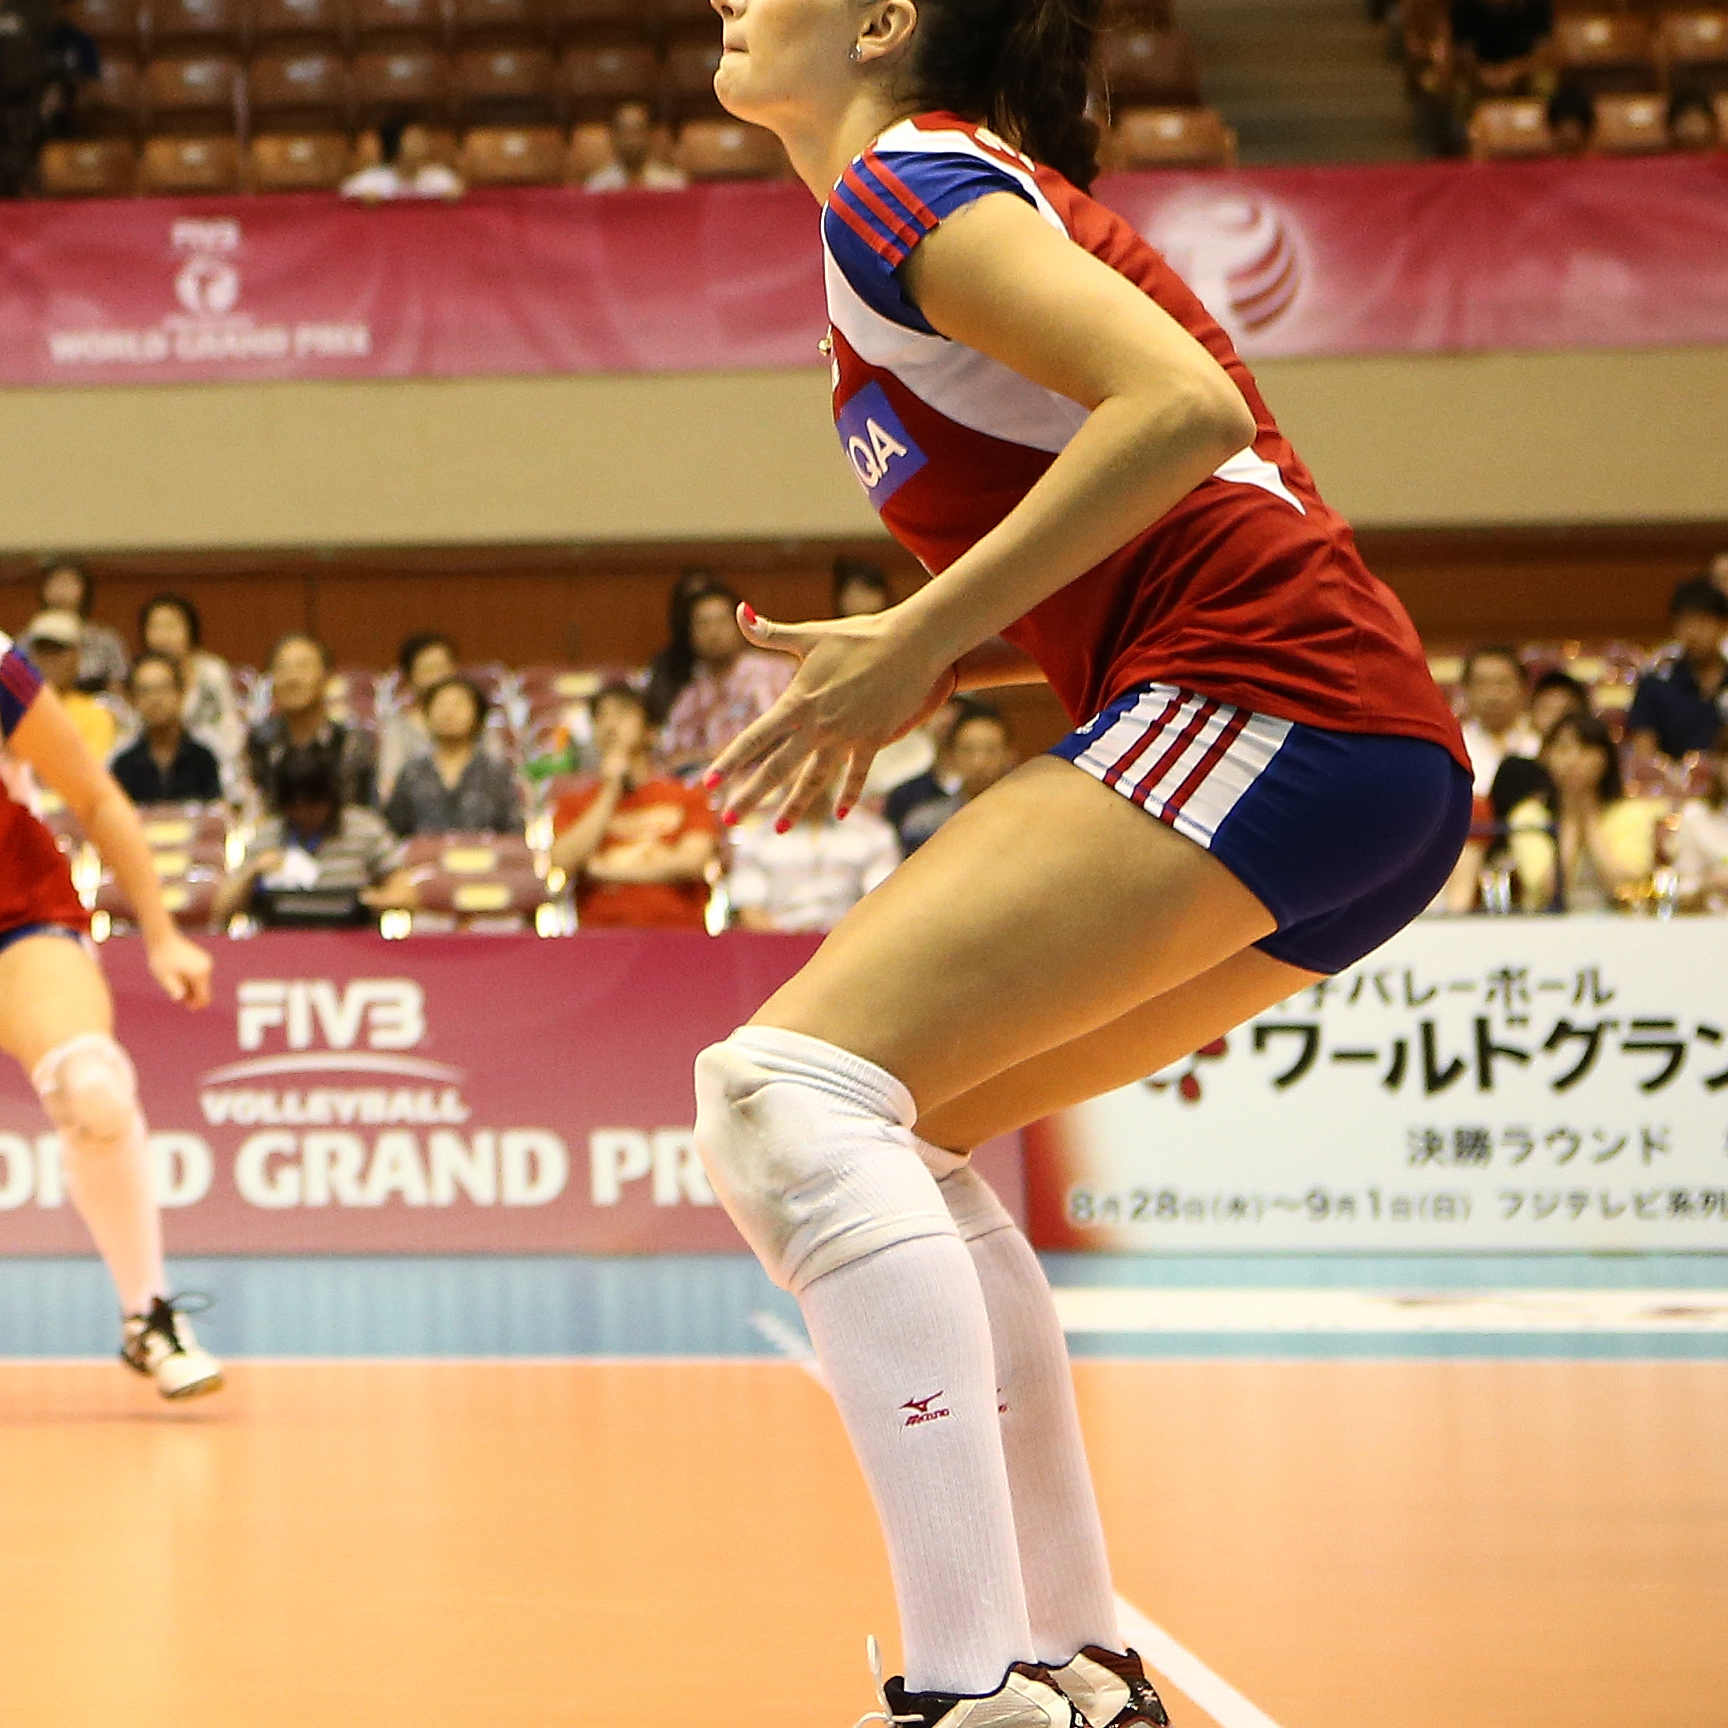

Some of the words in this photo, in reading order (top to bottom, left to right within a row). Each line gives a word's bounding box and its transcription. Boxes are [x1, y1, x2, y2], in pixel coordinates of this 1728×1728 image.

[237, 979, 427, 1050] FIVB
[199, 1087, 472, 1126] VOLLEYBALL
[234, 1128, 569, 1209] GRAND
[1407, 1125, 1673, 1169] 決勝ラウンド
